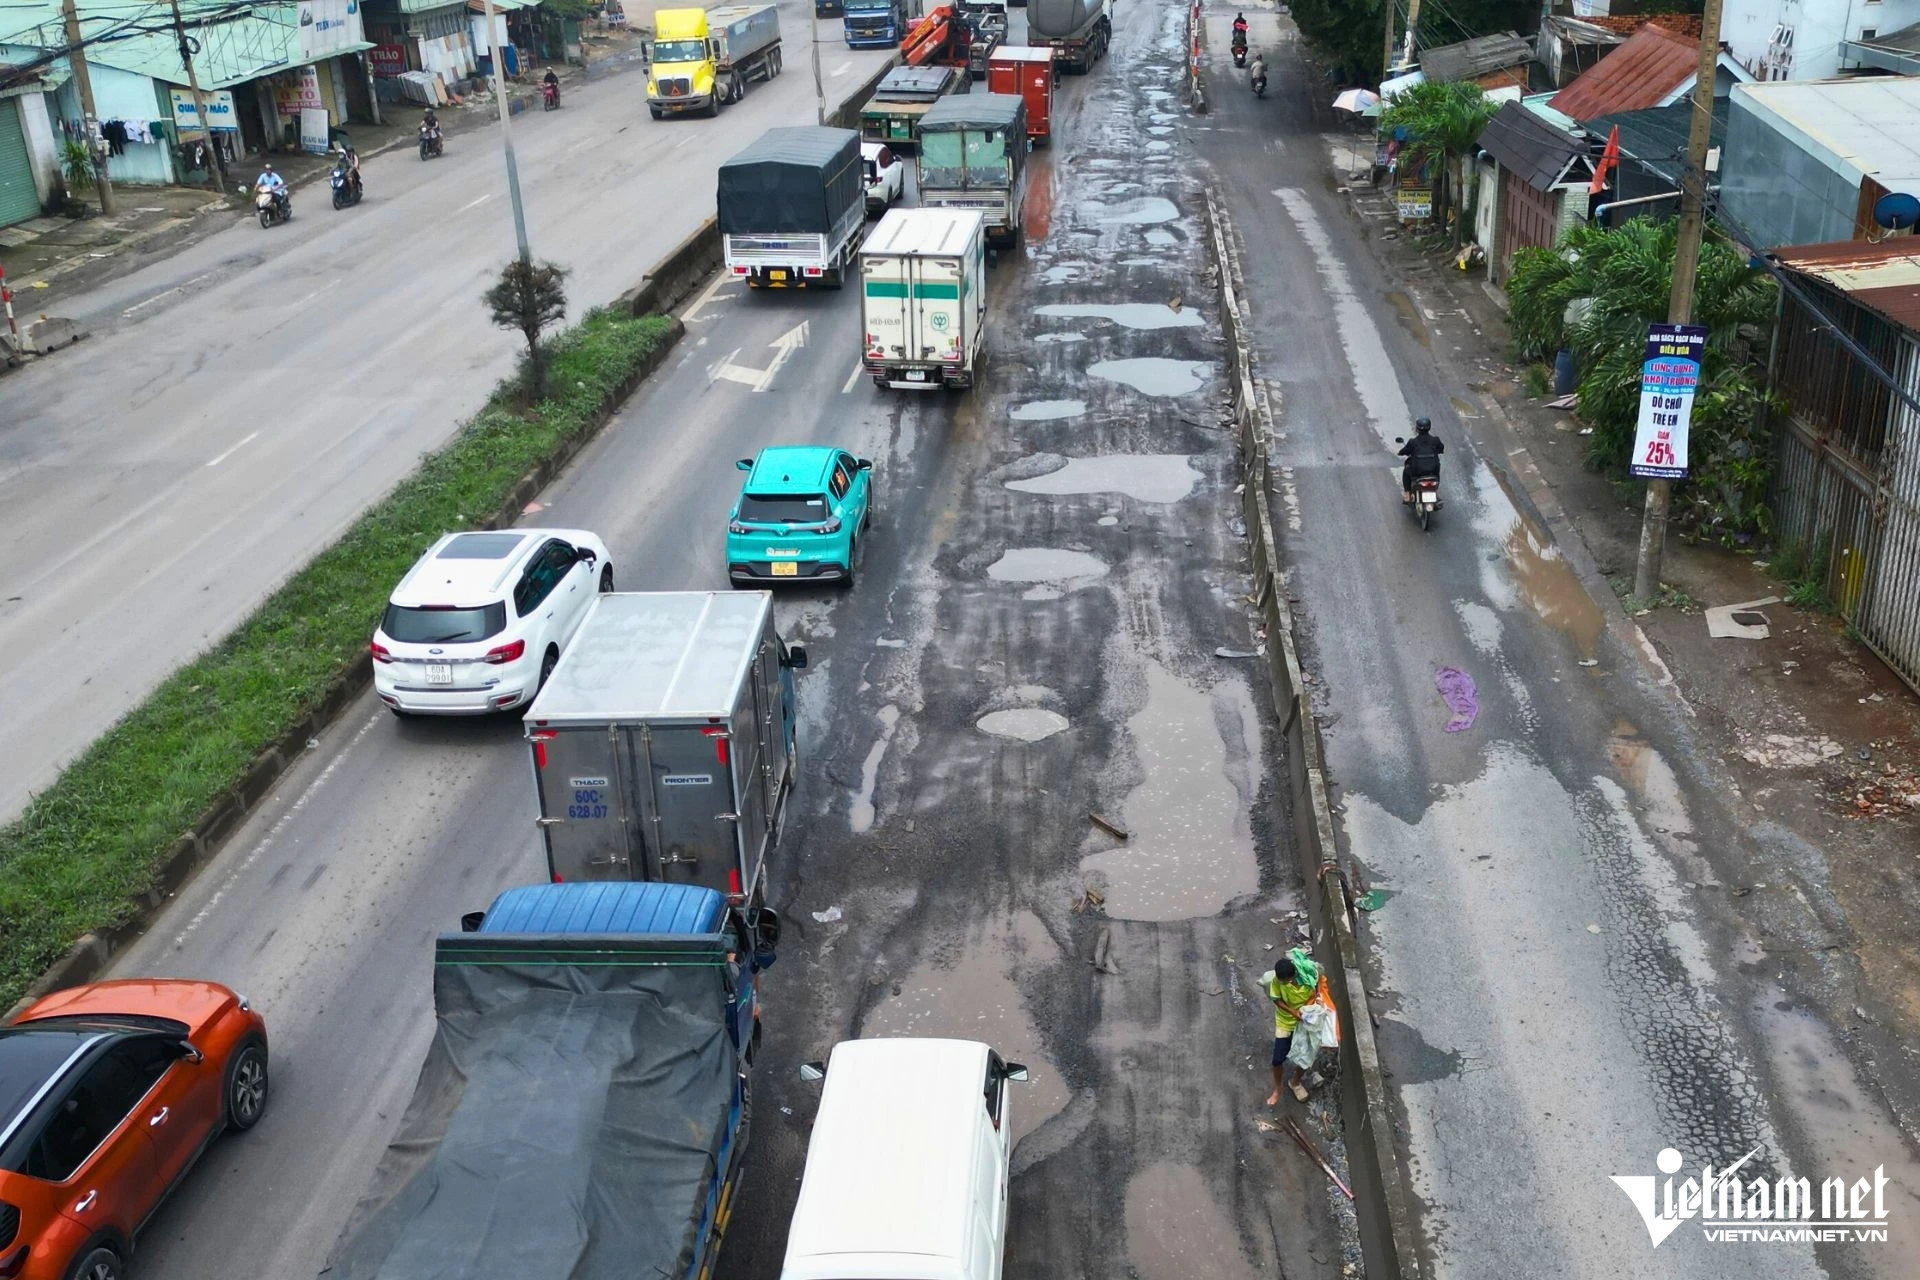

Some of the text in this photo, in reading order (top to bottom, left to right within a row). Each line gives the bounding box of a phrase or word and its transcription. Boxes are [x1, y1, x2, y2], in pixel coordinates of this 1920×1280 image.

[373, 48, 399, 60] THẢO
[1646, 441, 1675, 465] 25%
[664, 776, 710, 784] FRONTIER
[568, 805, 608, 818] 628.07
